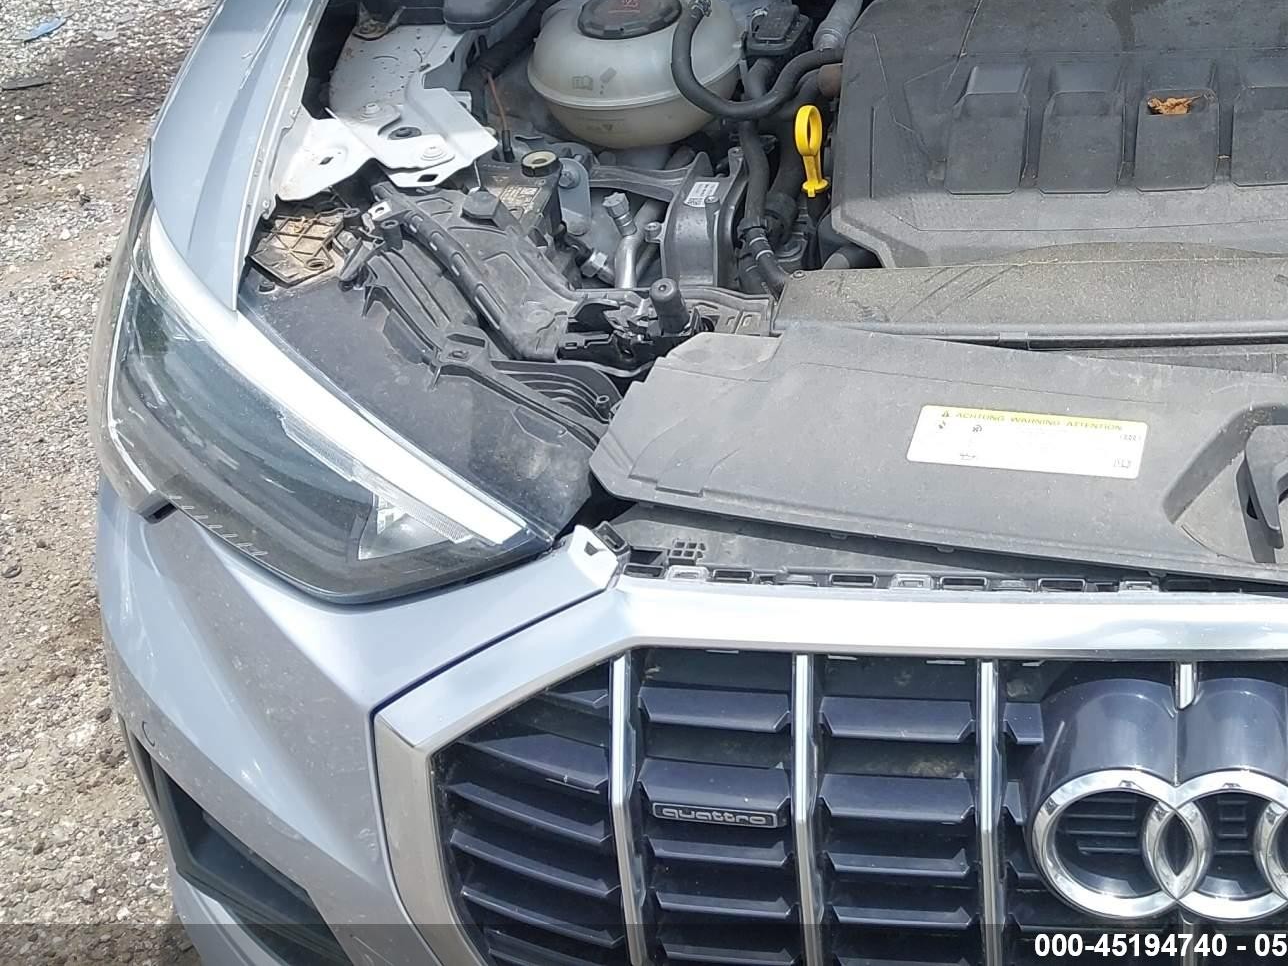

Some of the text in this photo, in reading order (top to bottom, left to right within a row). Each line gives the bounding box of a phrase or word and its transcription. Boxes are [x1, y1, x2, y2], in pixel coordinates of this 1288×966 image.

[956, 413, 1124, 431] ACHTUNG WARNING ATTENTION
[662, 807, 767, 825] quattro
